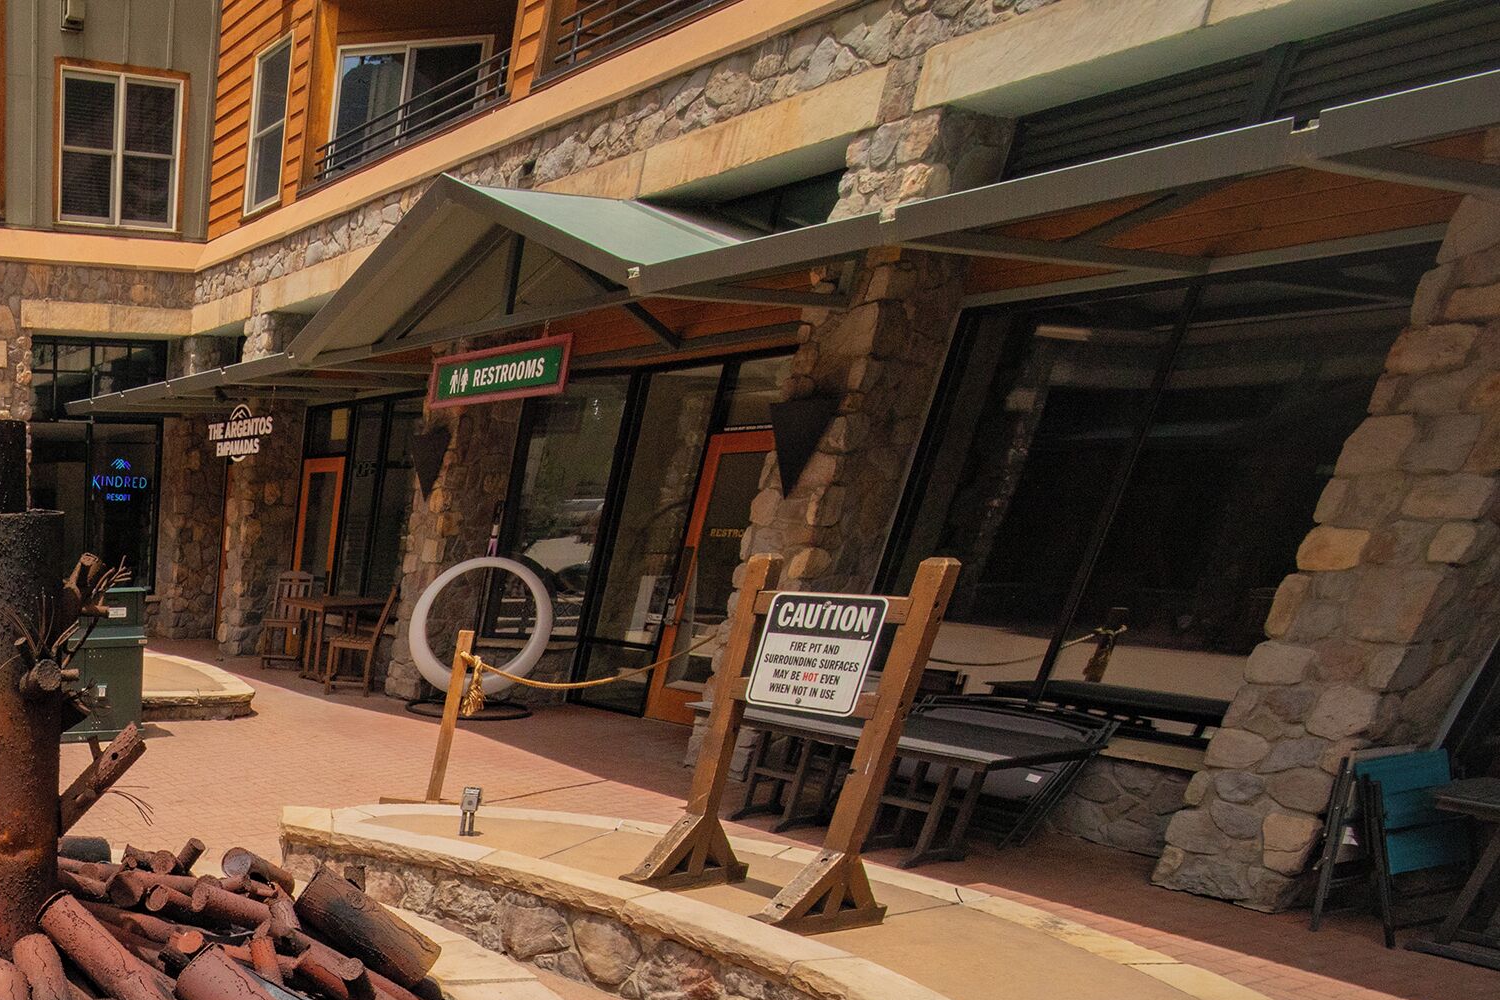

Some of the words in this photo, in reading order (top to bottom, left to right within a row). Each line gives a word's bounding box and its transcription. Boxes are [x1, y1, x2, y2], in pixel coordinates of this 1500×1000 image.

[472, 357, 545, 387] RESTROOMS
[208, 422, 224, 441] THE
[224, 416, 273, 439] ARGENTOS
[216, 438, 260, 457] EMPANADAS
[92, 474, 148, 490] KINDRED
[106, 493, 131, 502] RESORT
[710, 528, 745, 538] RESTRO
[777, 601, 876, 633] CAUTION
[789, 641, 808, 652] FIRE
[808, 643, 823, 653] PIT
[822, 644, 840, 655] AND
[763, 653, 818, 668] SURROUNDING
[818, 659, 860, 673] SURFACES
[772, 668, 790, 679] MAY
[790, 671, 802, 681] BE
[802, 672, 819, 683] HOT
[819, 673, 841, 685] EVEN
[768, 682, 791, 693] WHEN
[791, 685, 809, 696] NOT
[809, 687, 819, 697] IN
[819, 689, 836, 700] USE
